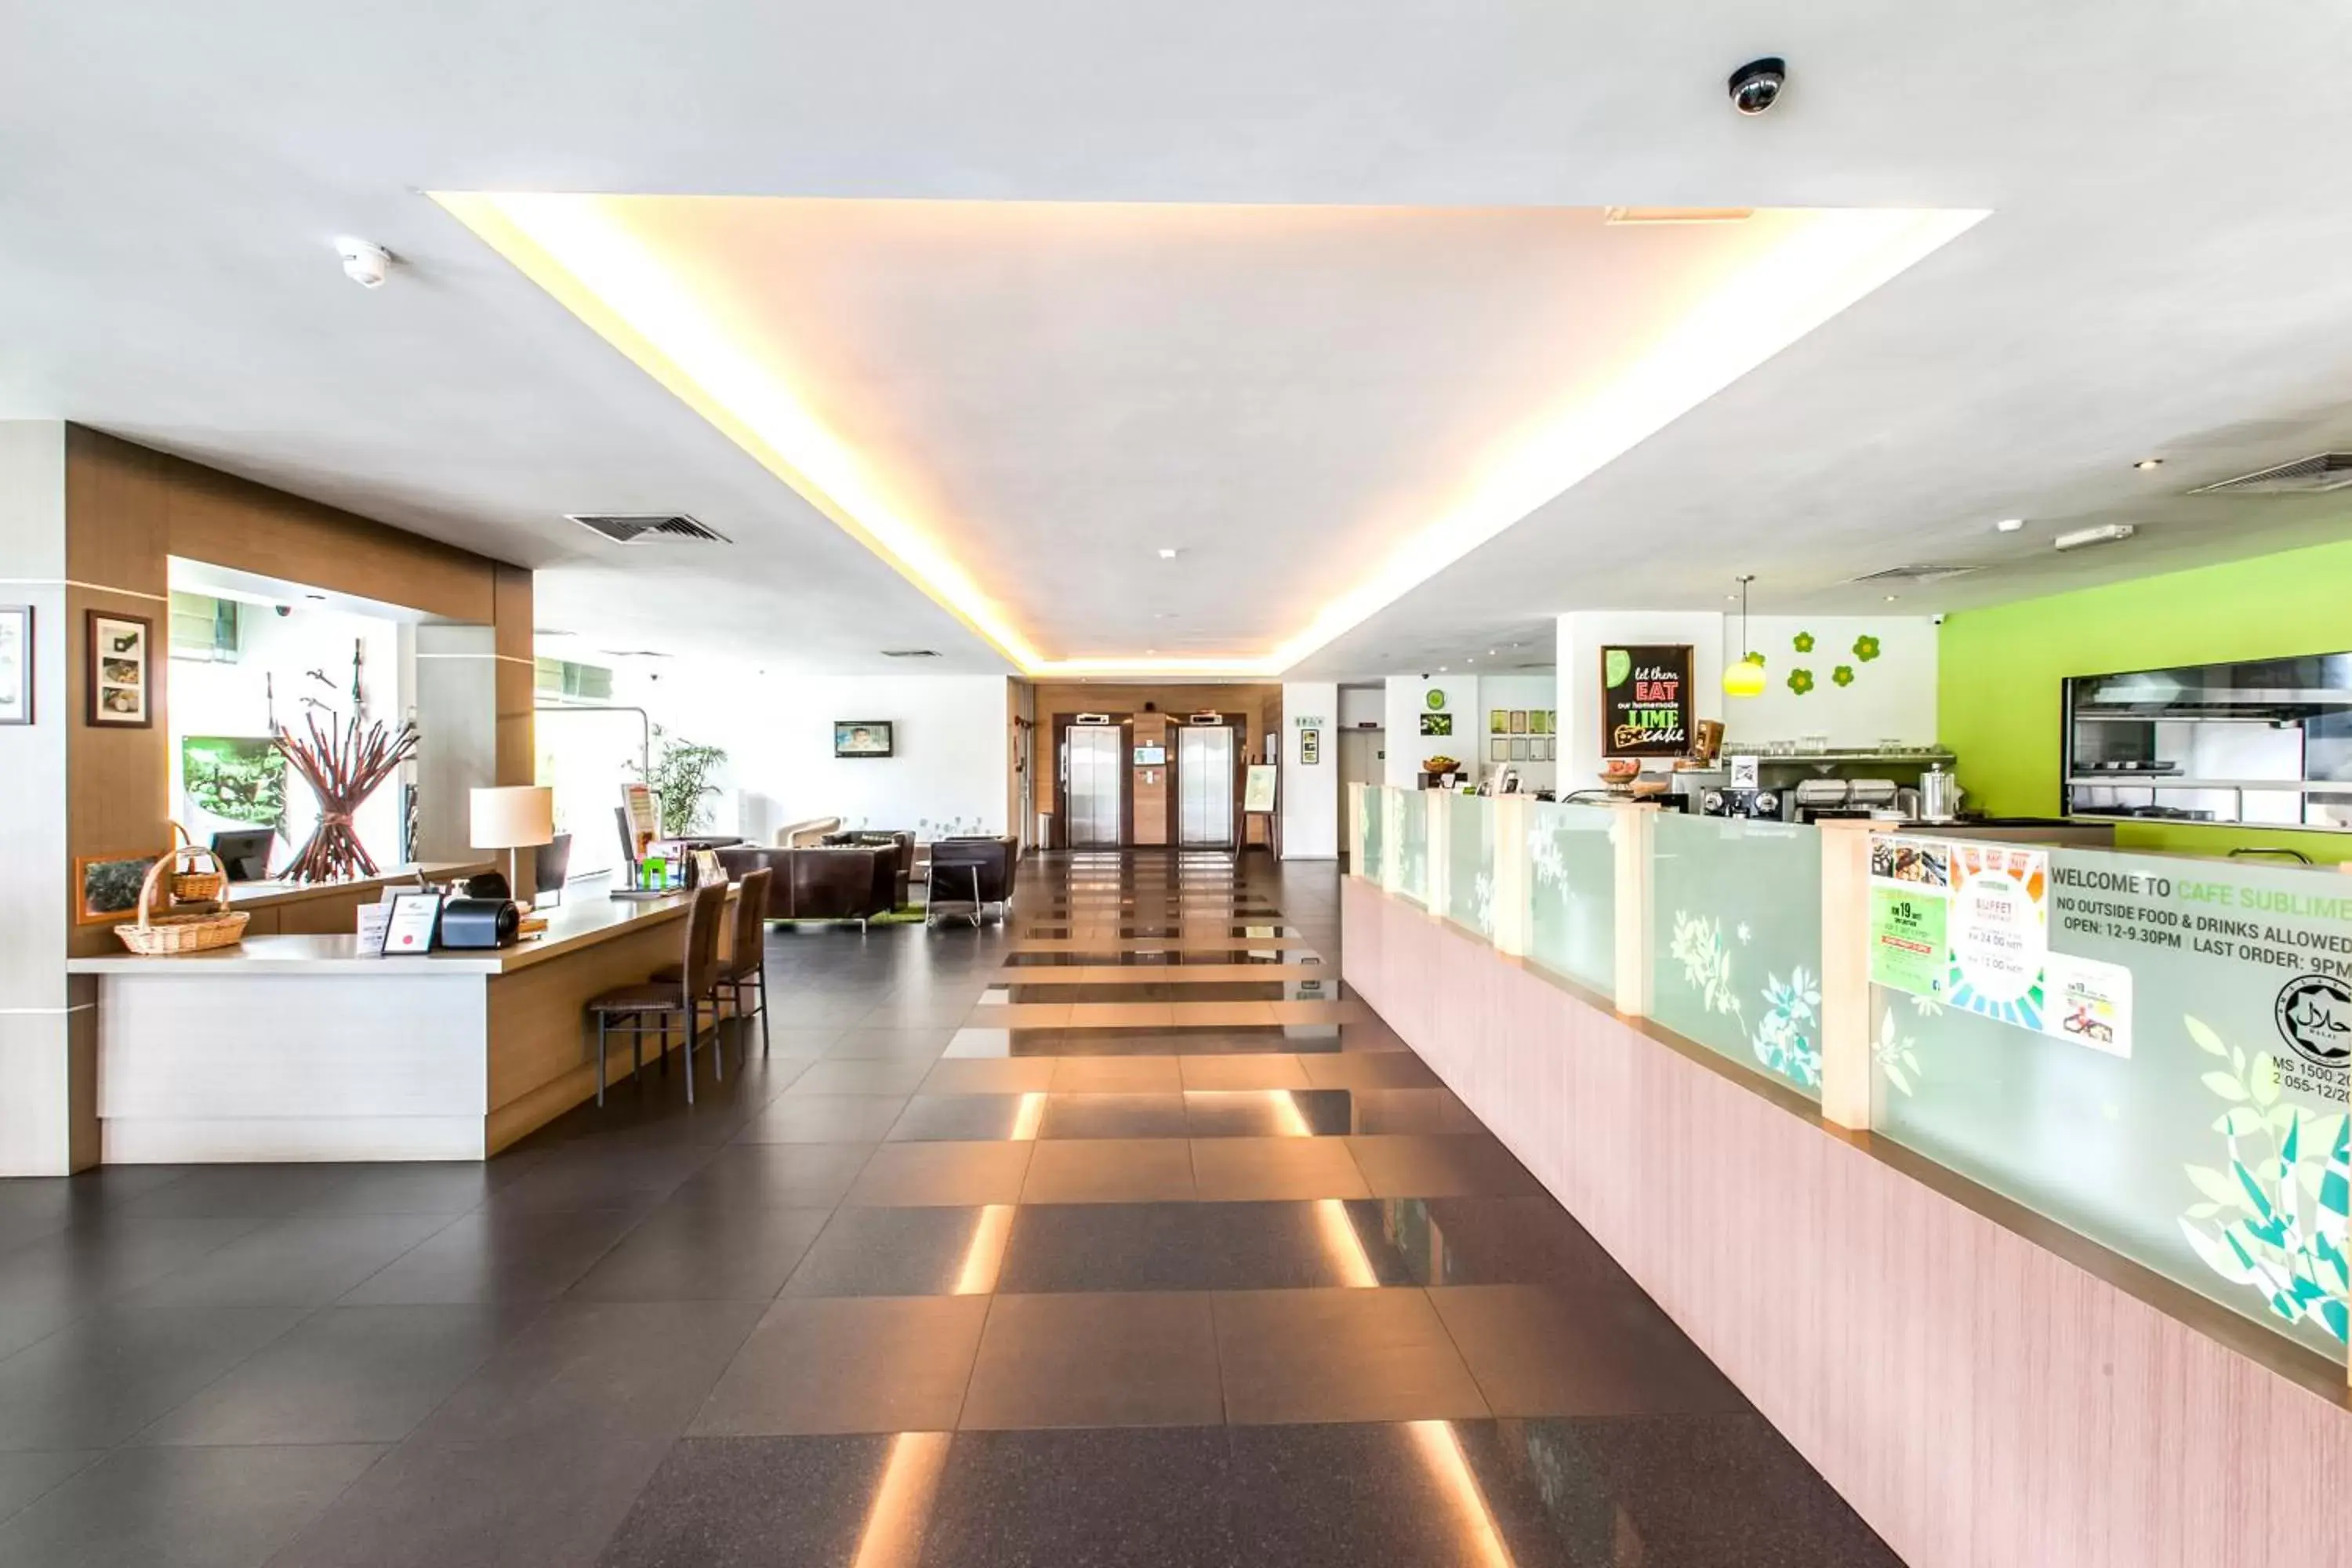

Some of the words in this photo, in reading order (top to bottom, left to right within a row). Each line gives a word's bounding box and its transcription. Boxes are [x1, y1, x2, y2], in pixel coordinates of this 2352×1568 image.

[1635, 666, 1650, 681] let
[1650, 666, 1679, 681] them
[1635, 681, 1679, 701] EAT
[1632, 701, 1679, 710] homemade
[1628, 710, 1679, 728] LIME
[1642, 724, 1685, 743] cake
[2051, 866, 2140, 894] WELCOME
[2145, 877, 2171, 898] TO
[2178, 880, 2234, 906] CAFE
[2239, 887, 2352, 921] SUBLIME
[1900, 902, 1911, 918] 19
[2056, 896, 2075, 911] NO
[2078, 899, 2135, 920] OUTSIDE
[2138, 907, 2178, 927] FOOD
[2182, 913, 2192, 929] &
[2197, 916, 2259, 939] DRINKS
[2264, 926, 2352, 954] ALLOWED
[2064, 916, 2103, 935] OPEN:
[2107, 923, 2182, 949] 12-9.30PM
[2194, 937, 2234, 957] LAST
[2239, 944, 2304, 971] ORDER:
[2310, 956, 2352, 979] 9PM
[2272, 1055, 2295, 1072] MS
[2272, 1072, 2281, 1084] 2
